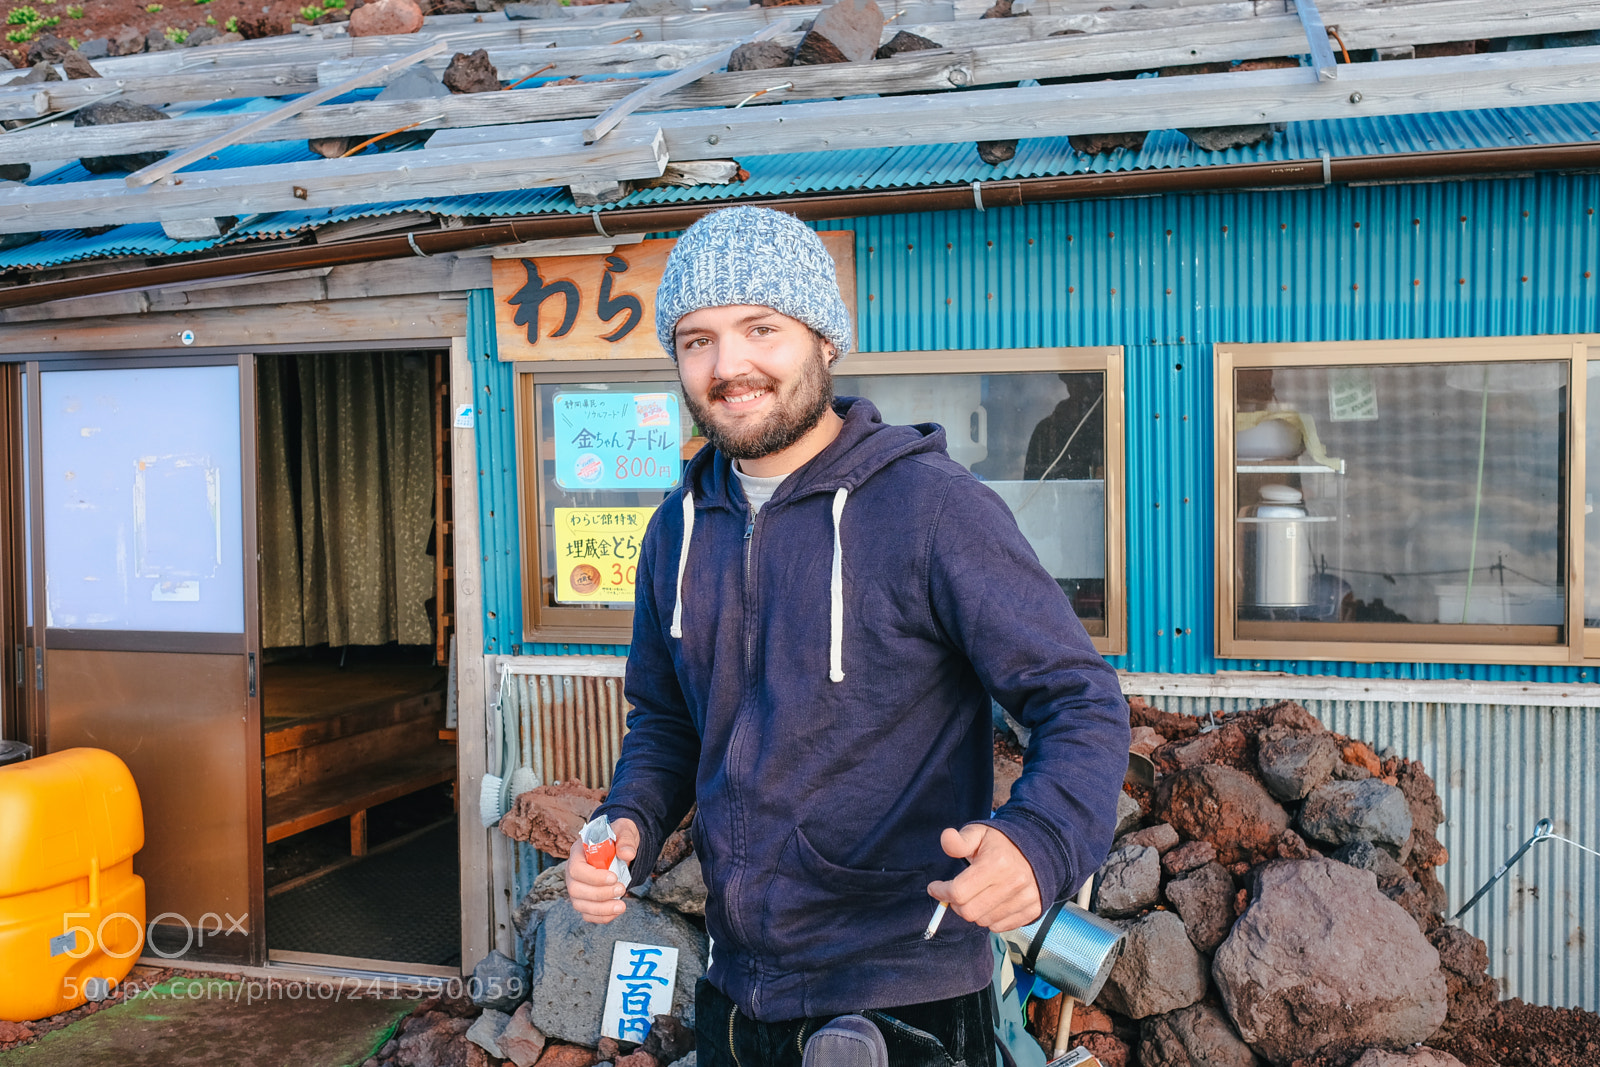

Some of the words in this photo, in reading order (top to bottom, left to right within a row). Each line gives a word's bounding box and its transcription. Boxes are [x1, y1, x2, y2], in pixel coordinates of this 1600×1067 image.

[506, 256, 643, 344] わら
[615, 455, 671, 480] 800円
[570, 513, 638, 526] わらじ館特製
[566, 535, 643, 559] 埋蔵金どら
[616, 948, 669, 1044] 五百円
